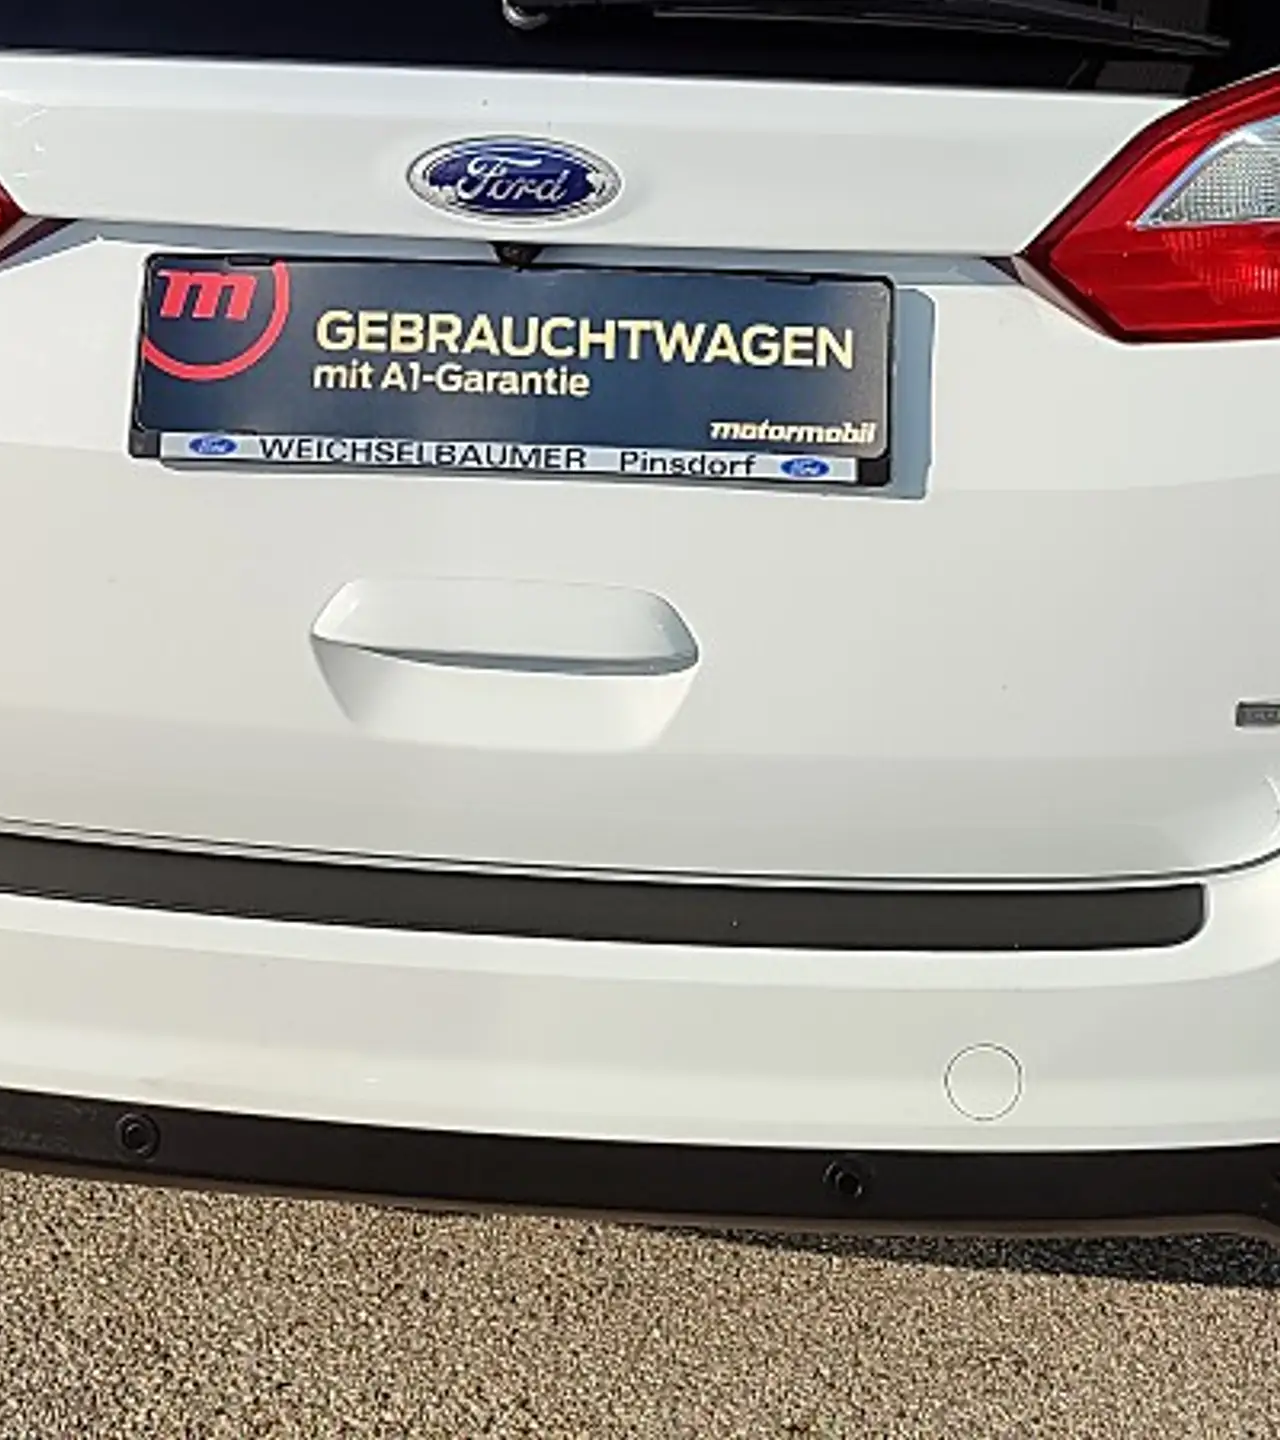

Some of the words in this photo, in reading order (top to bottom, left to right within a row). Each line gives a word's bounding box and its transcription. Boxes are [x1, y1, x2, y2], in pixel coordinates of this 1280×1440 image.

[456, 155, 570, 203] Ford
[315, 309, 855, 370] GEBRAUCHTWAGEN
[312, 358, 372, 391] mit
[380, 360, 591, 398] A1-Garantie
[710, 418, 877, 445] motormobil
[259, 437, 587, 469] WEICHSELBAUMER
[620, 450, 757, 476] Pinsdorf
